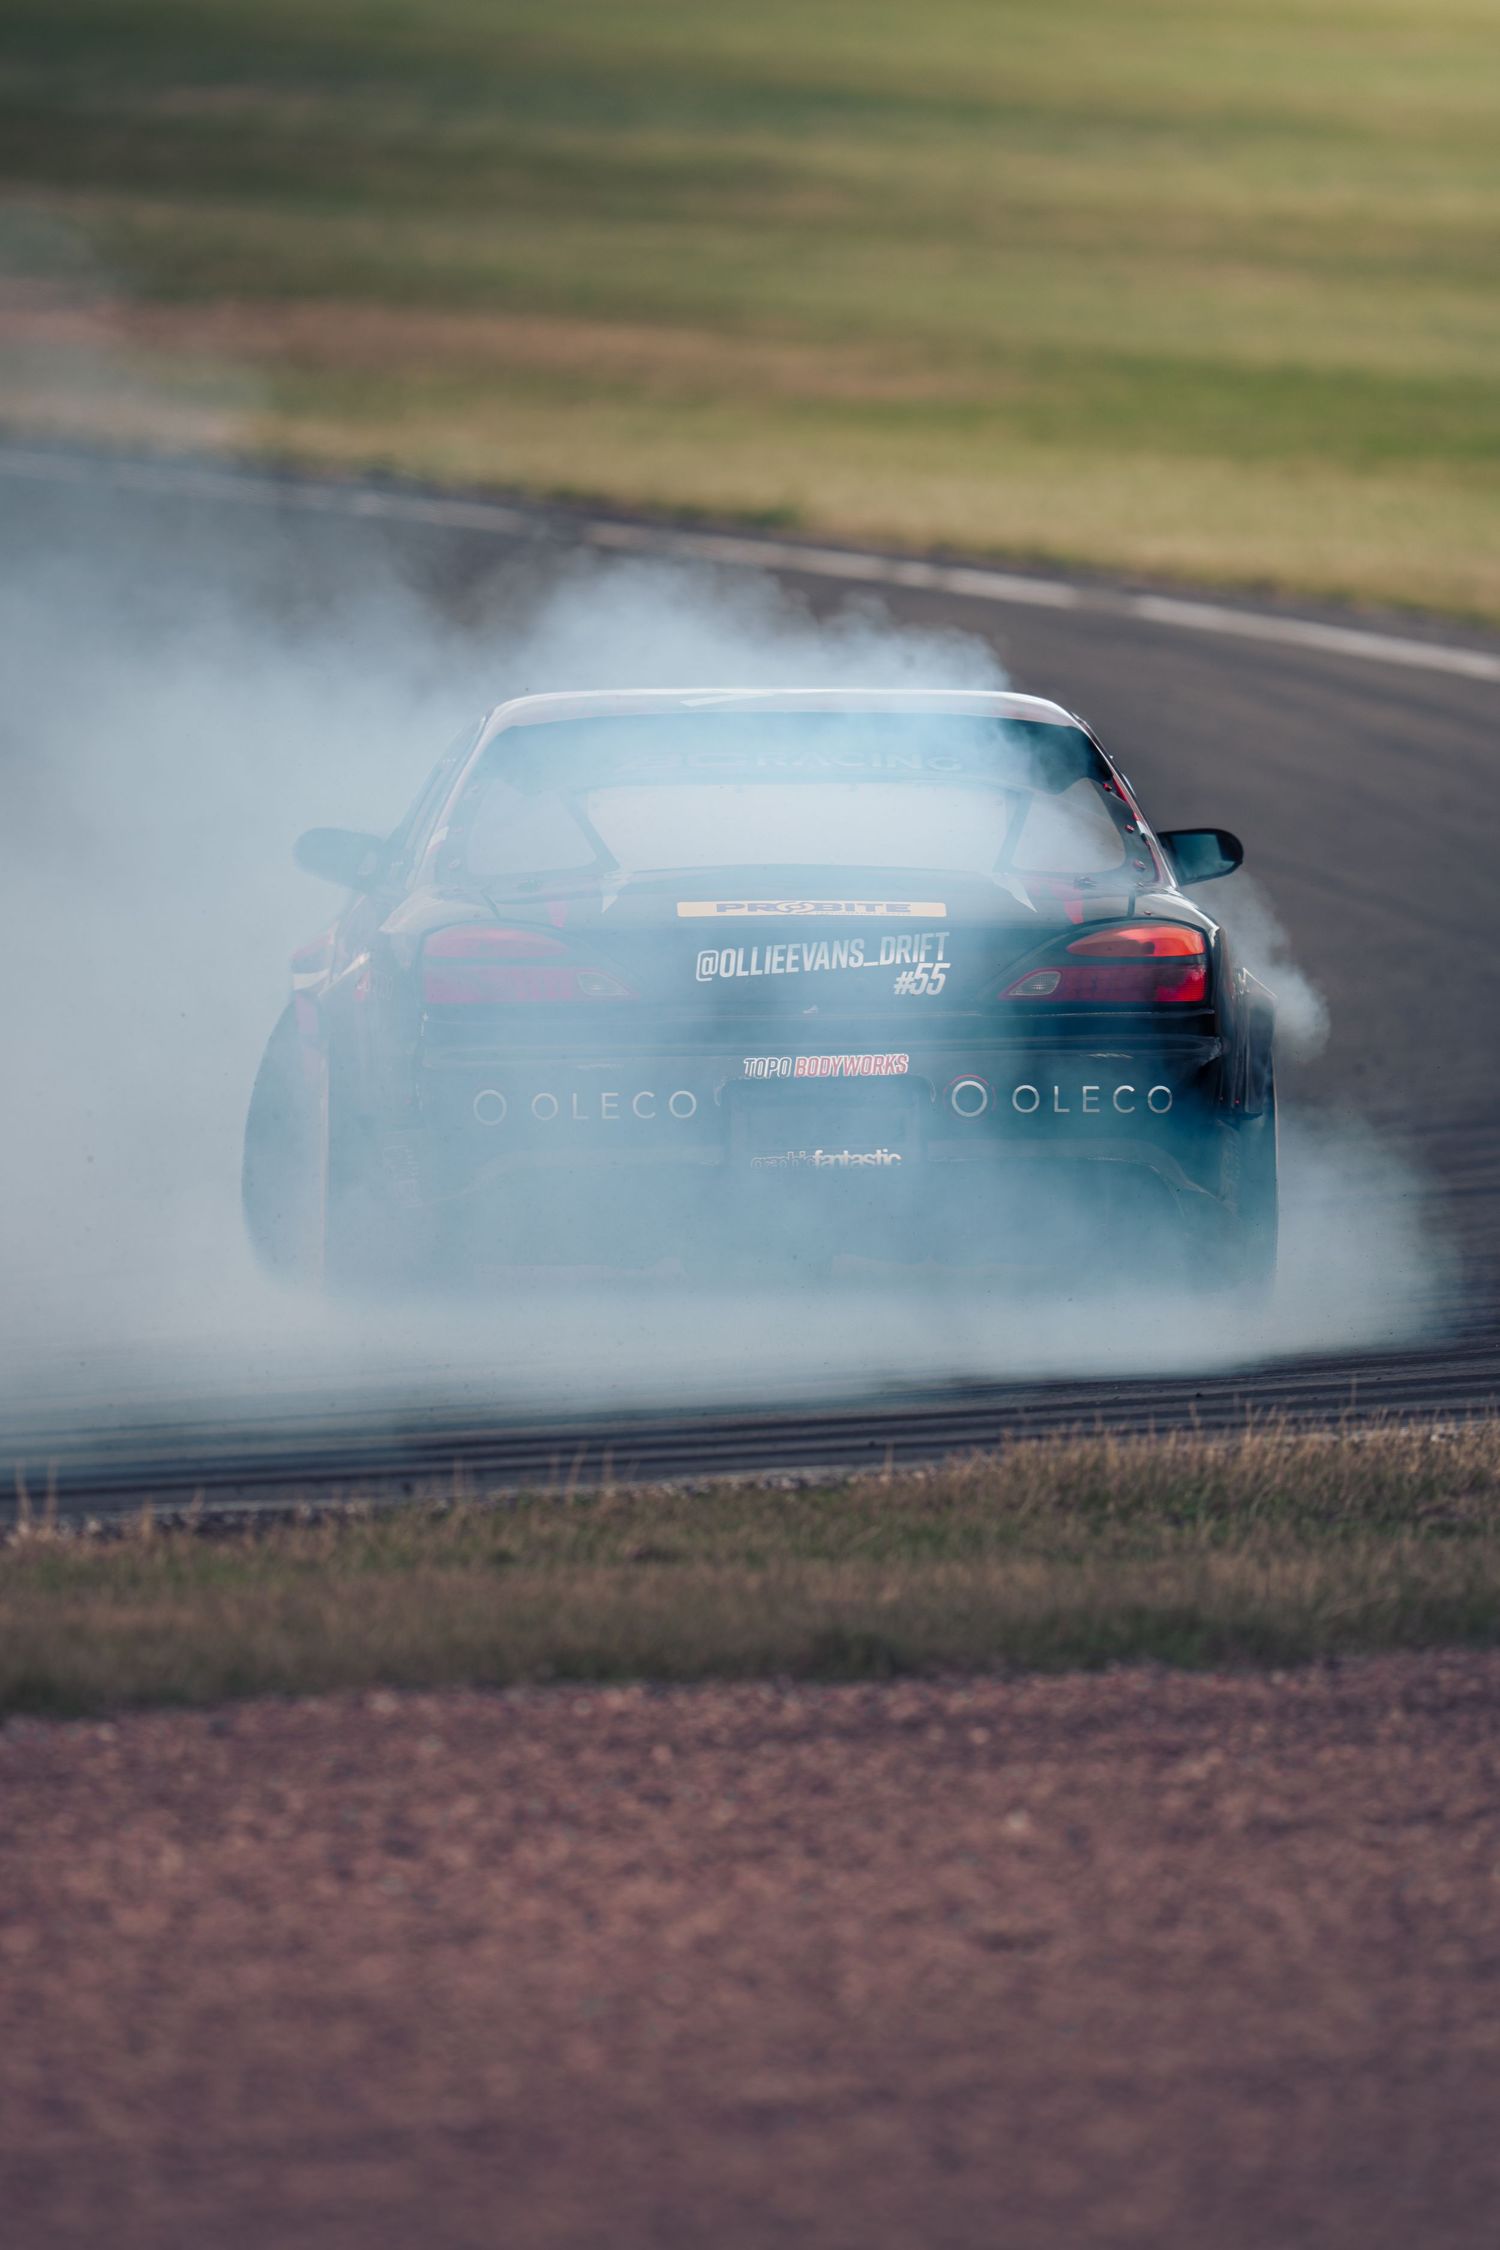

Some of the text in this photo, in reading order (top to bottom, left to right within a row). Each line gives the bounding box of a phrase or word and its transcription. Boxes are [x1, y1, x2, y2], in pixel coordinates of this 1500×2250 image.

[696, 931, 950, 982] @OLLIEEVANS_DRIFT
[894, 962, 951, 996] #55
[743, 1053, 909, 1079] TOPO BODYWORKS
[531, 1090, 698, 1121] OLECO
[1012, 1084, 1173, 1114] OLECO
